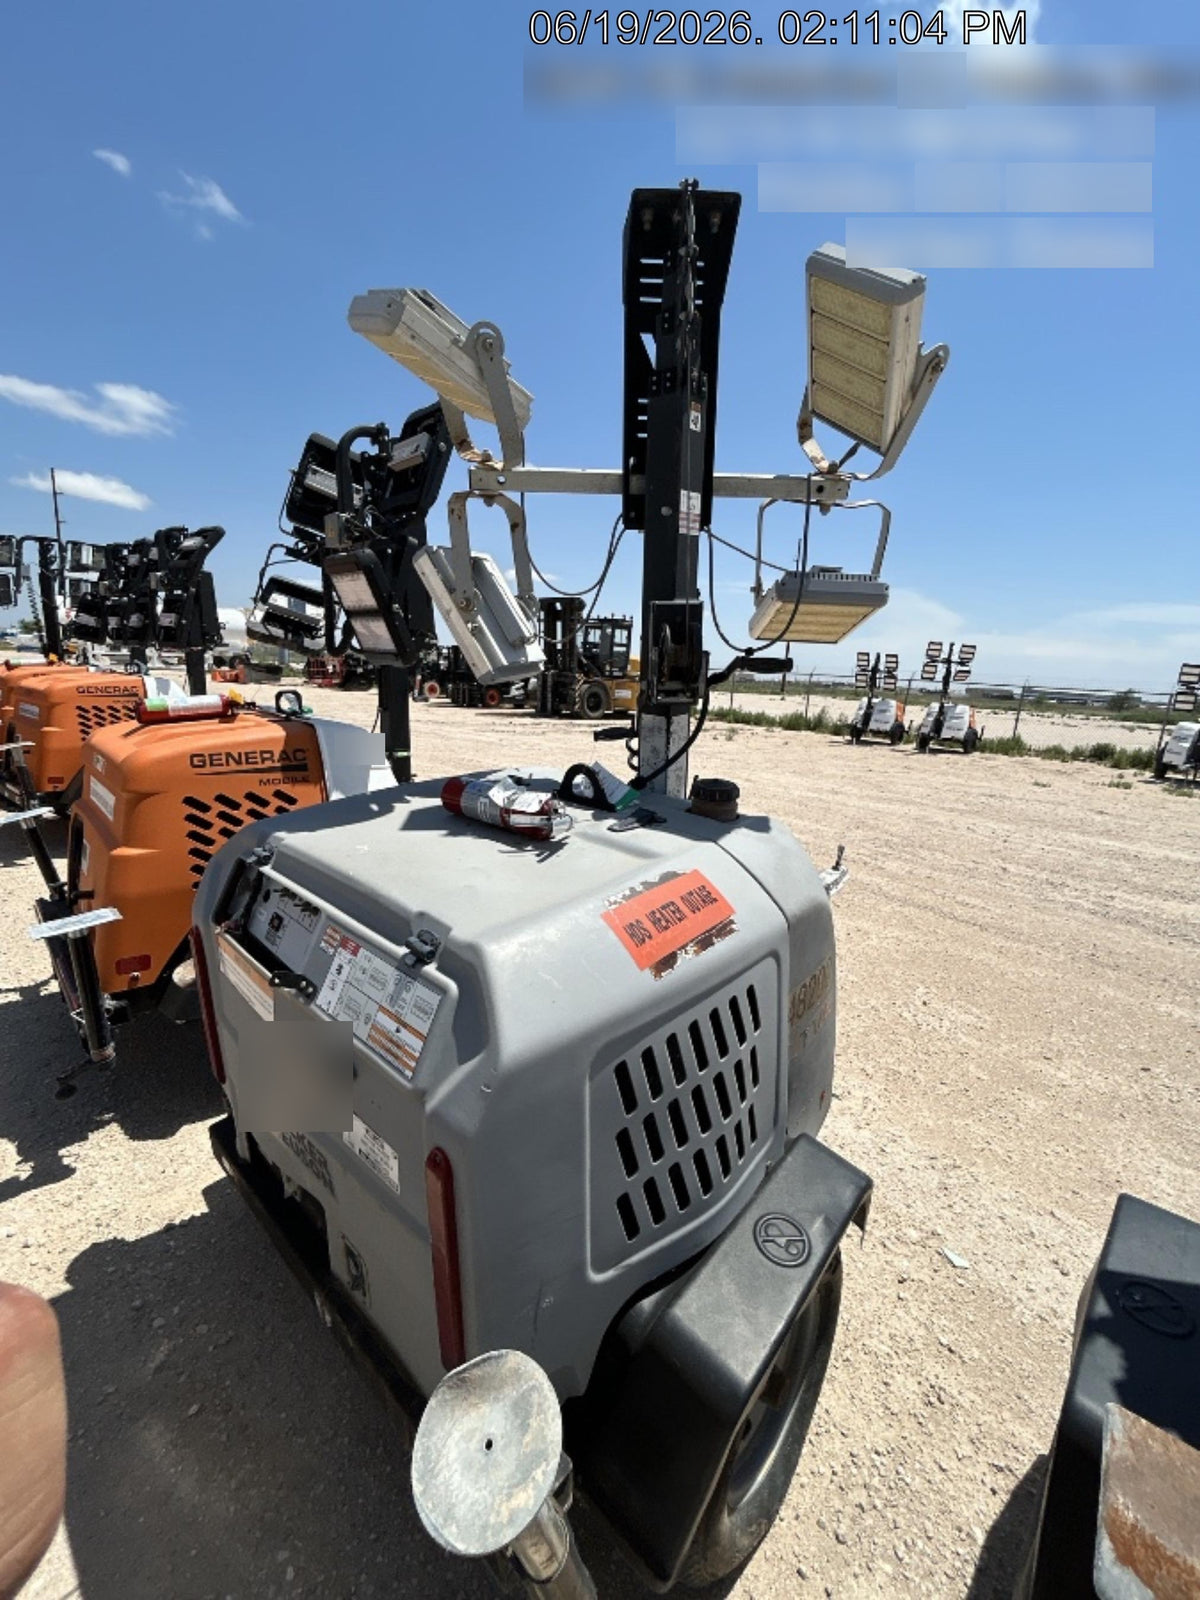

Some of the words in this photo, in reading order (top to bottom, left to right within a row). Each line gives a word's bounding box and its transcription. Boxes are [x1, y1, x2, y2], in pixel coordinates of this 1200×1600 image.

[76, 685, 139, 694] GENERAC
[189, 748, 307, 769] GENERAC
[258, 776, 310, 787] MOBILE
[645, 901, 687, 934] HEATER
